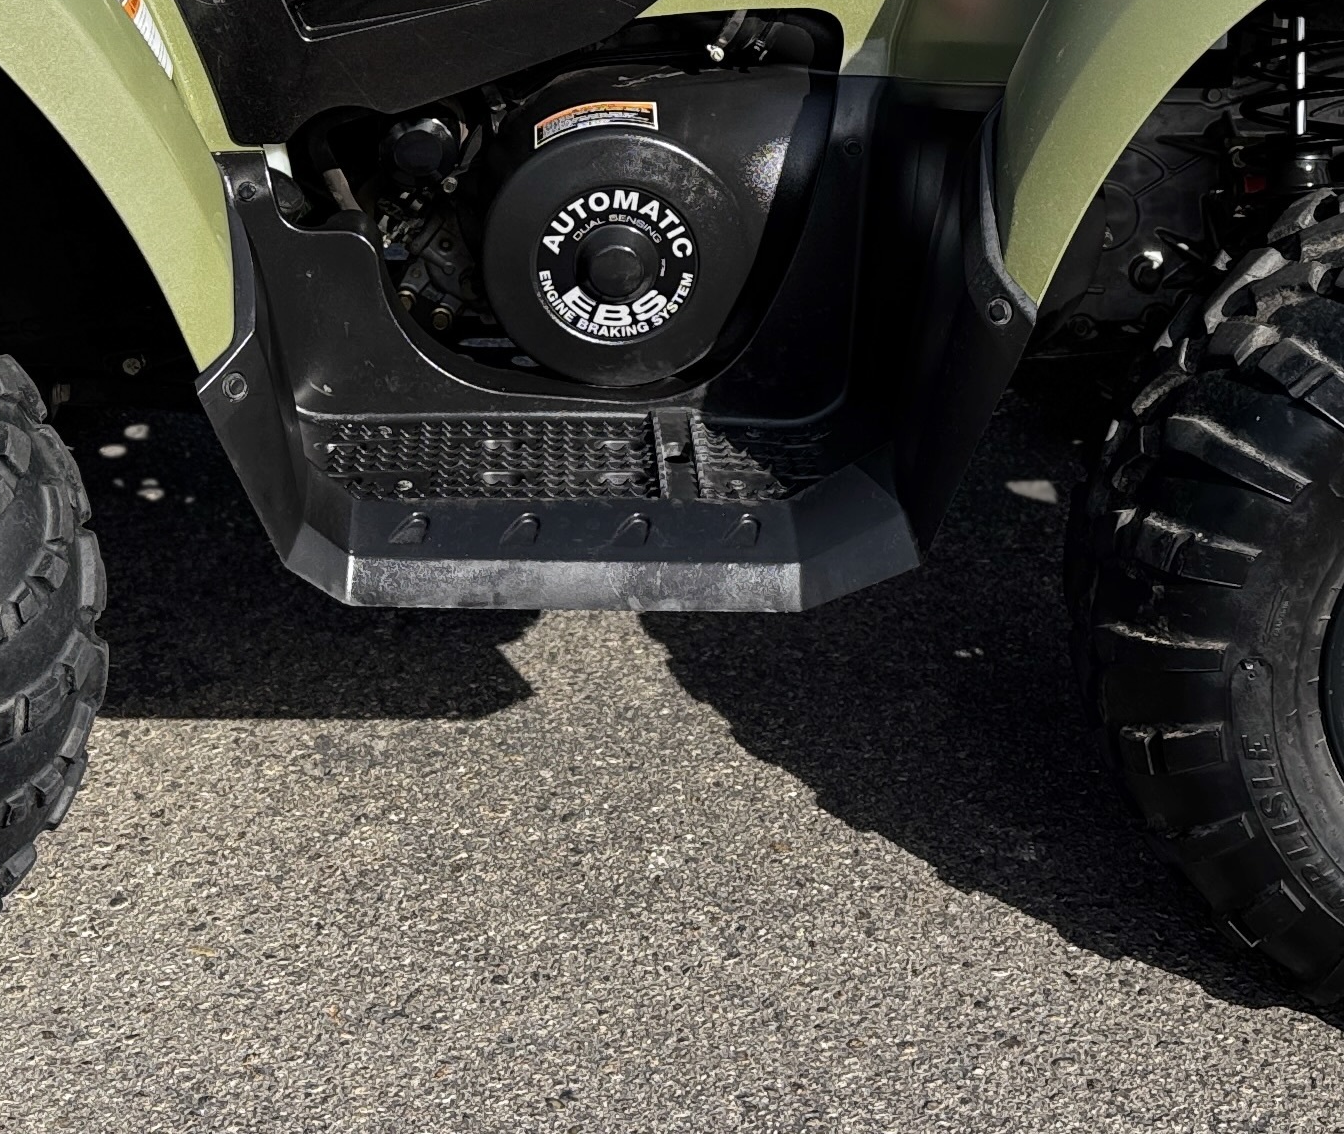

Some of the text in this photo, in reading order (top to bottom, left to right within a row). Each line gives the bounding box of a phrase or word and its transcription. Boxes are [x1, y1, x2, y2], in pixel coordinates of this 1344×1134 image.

[542, 190, 693, 258] AUTOMATIC
[572, 214, 662, 244] DUAL SENSING
[538, 270, 694, 337] ENGINE BRAKING SYSTEM
[561, 285, 668, 327] EBS
